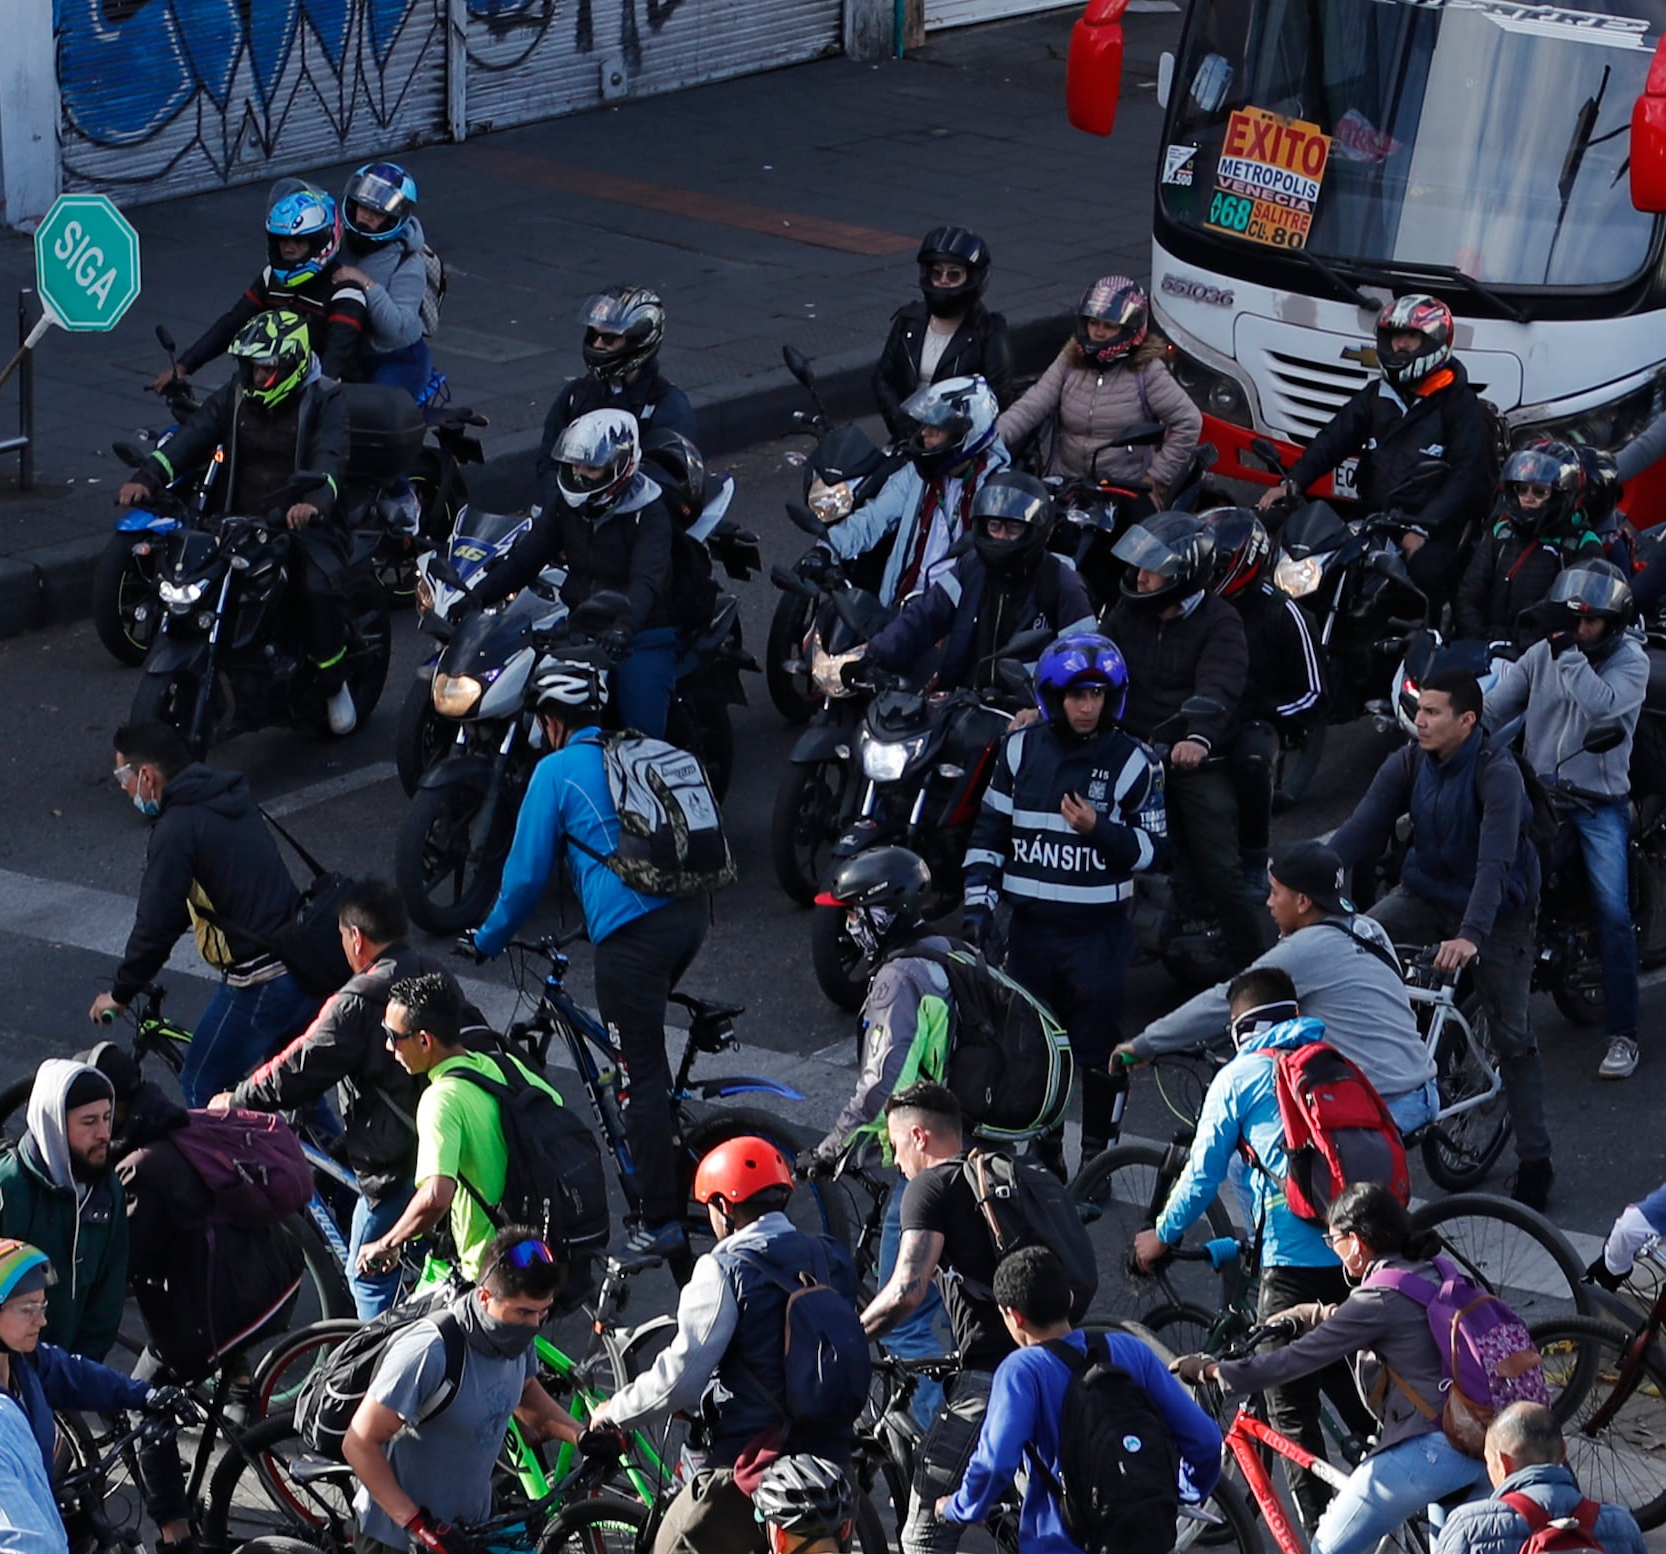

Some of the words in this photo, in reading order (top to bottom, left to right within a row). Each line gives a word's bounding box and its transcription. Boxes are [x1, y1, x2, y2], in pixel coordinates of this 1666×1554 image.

[1223, 112, 1327, 177] EXITO
[1218, 176, 1310, 213] VENECIA
[1219, 158, 1318, 200] METROPOLIS
[1220, 194, 1252, 232] 68
[1253, 202, 1311, 233] SALITRE
[1270, 227, 1304, 250] 80
[53, 219, 120, 310] SIGA
[453, 545, 488, 562] 46
[309, 1205, 350, 1266] SPECIAL
